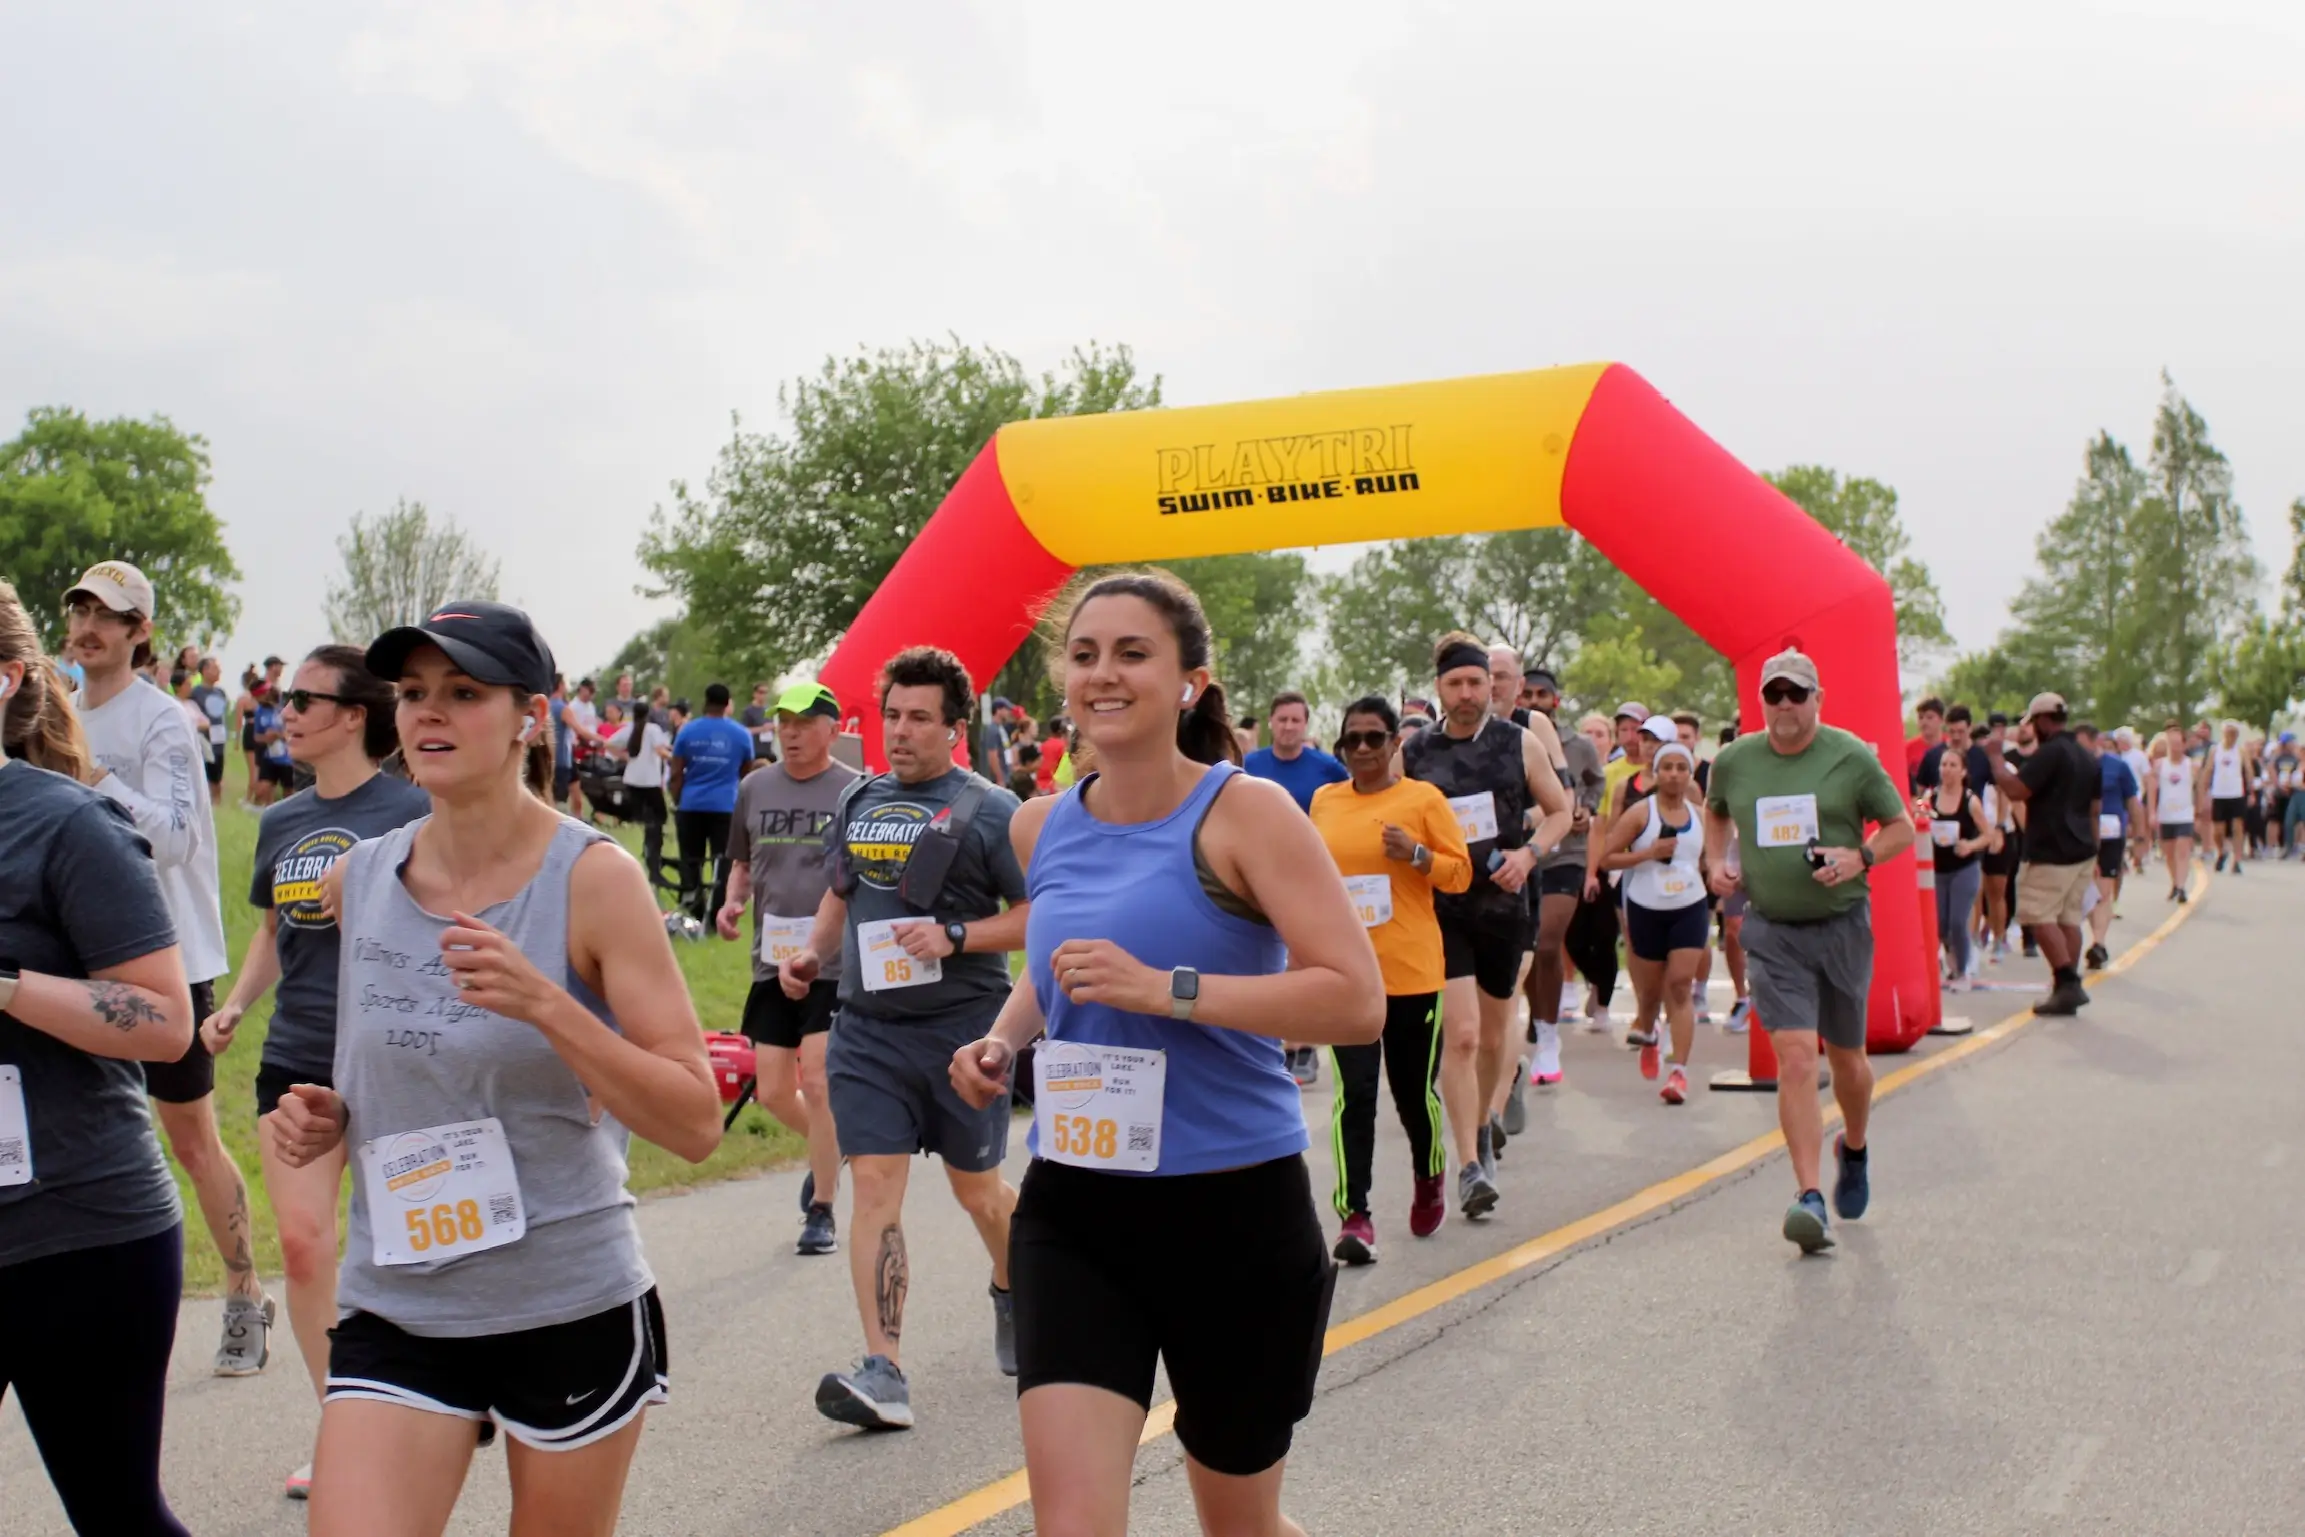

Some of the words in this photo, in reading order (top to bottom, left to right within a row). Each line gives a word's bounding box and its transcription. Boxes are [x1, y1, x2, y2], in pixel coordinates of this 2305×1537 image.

[1156, 424, 1416, 494] PLAYTRI
[846, 820, 927, 843] CELEBRATI
[1771, 823, 1800, 842] 482
[884, 957, 912, 983] 85
[1053, 1113, 1118, 1159] 538
[404, 1198, 485, 1252] 568
